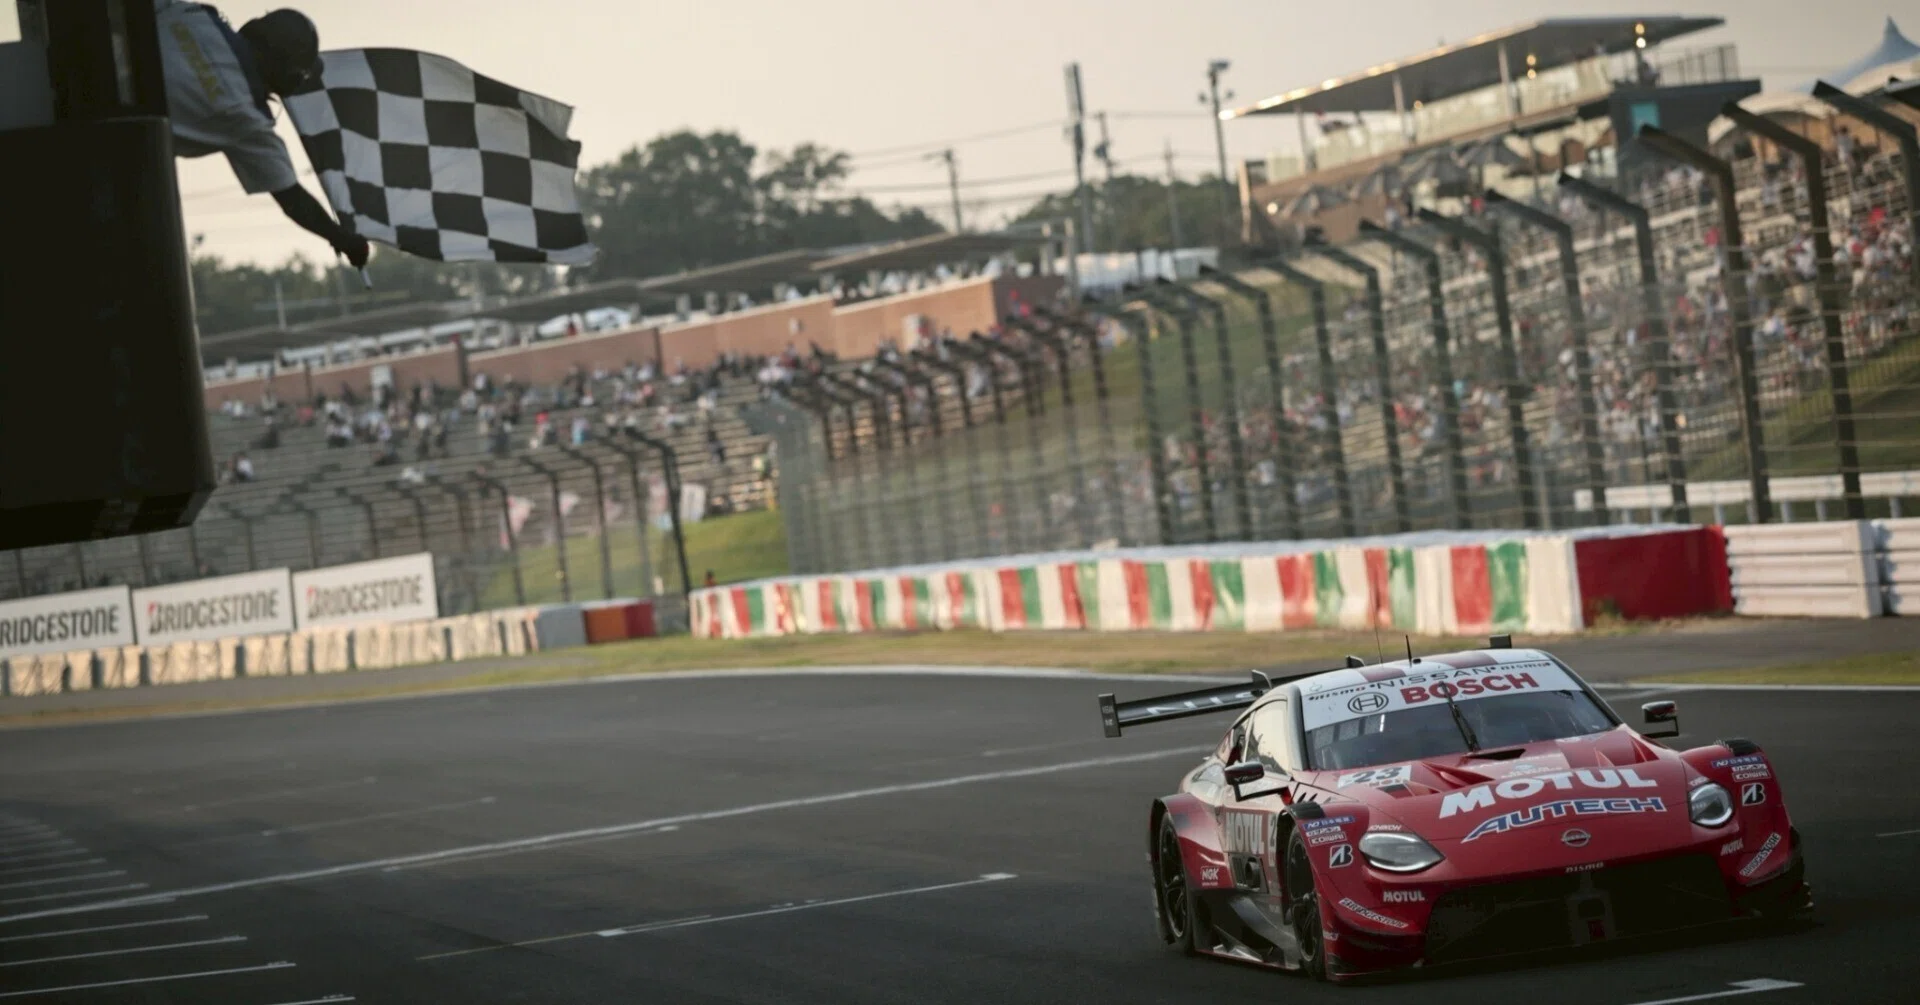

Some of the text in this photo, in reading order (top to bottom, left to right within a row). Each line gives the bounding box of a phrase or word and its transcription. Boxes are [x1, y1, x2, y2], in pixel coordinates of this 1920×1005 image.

[148, 590, 278, 634] BRIDGESTONE
[307, 574, 422, 618] BRIDGESTONE
[0, 605, 118, 647] RIDGESTONE
[1377, 667, 1489, 690] NISSAN
[1400, 672, 1540, 704] BOSCH
[1352, 767, 1402, 783] 23
[1439, 769, 1658, 818] MOTUL
[1225, 811, 1265, 855] MOTUL
[1461, 797, 1667, 844] AUTECH
[1201, 867, 1220, 881] NGK
[1383, 890, 1425, 903] MOTUL
